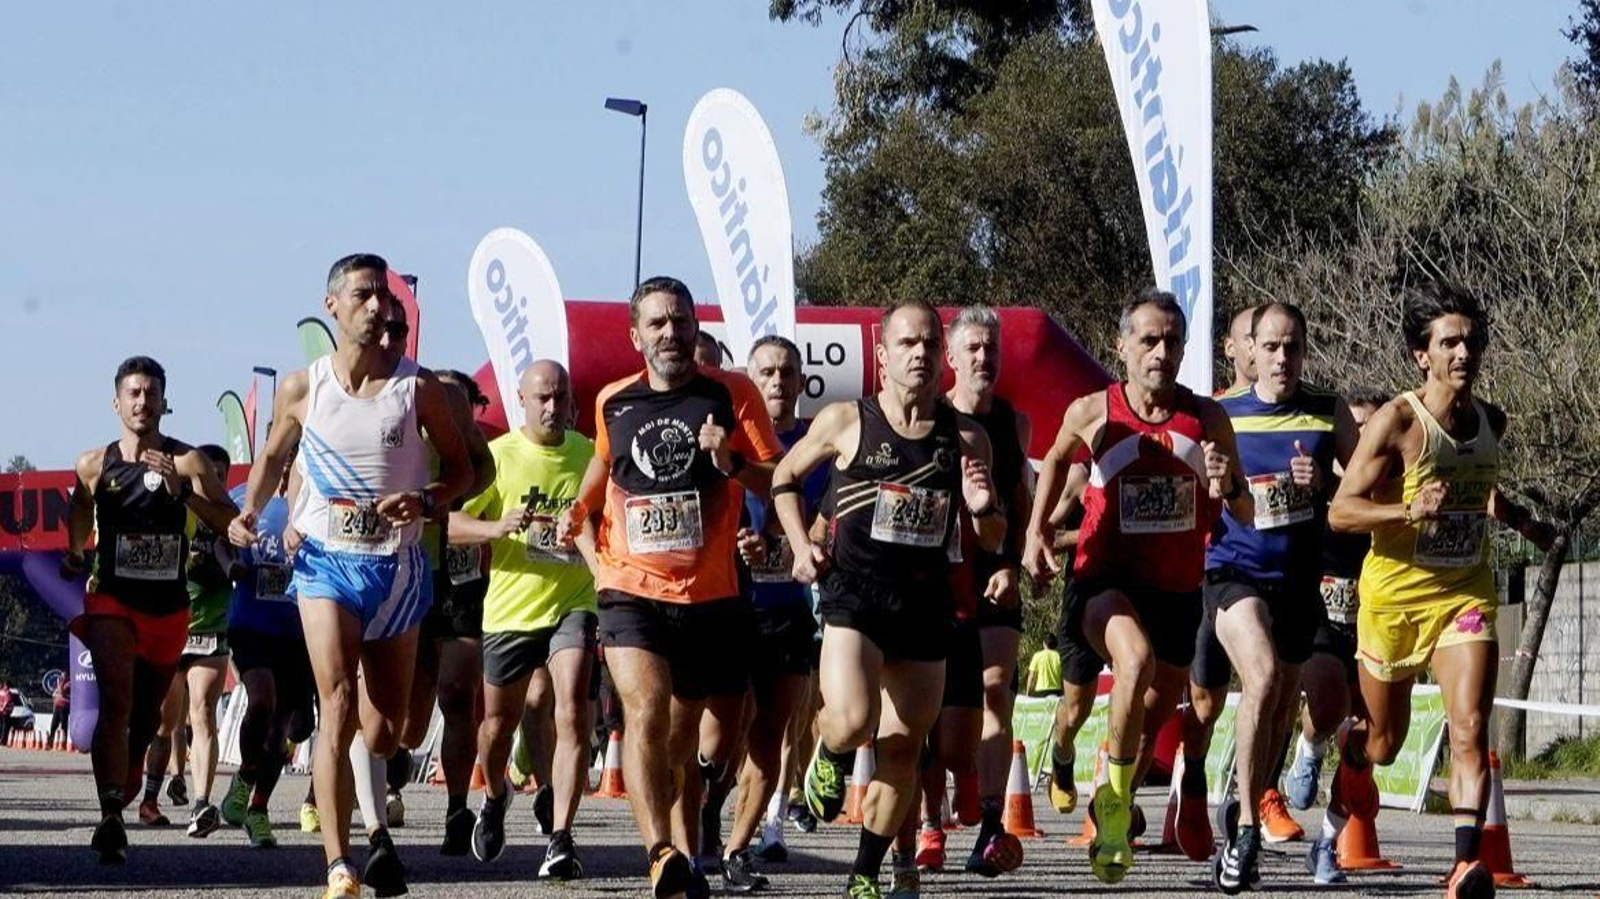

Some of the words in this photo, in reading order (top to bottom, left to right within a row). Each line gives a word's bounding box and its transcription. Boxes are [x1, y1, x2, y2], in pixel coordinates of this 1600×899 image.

[657, 418, 670, 426] DE
[671, 418, 695, 444] MONTE
[641, 507, 677, 534] 233
